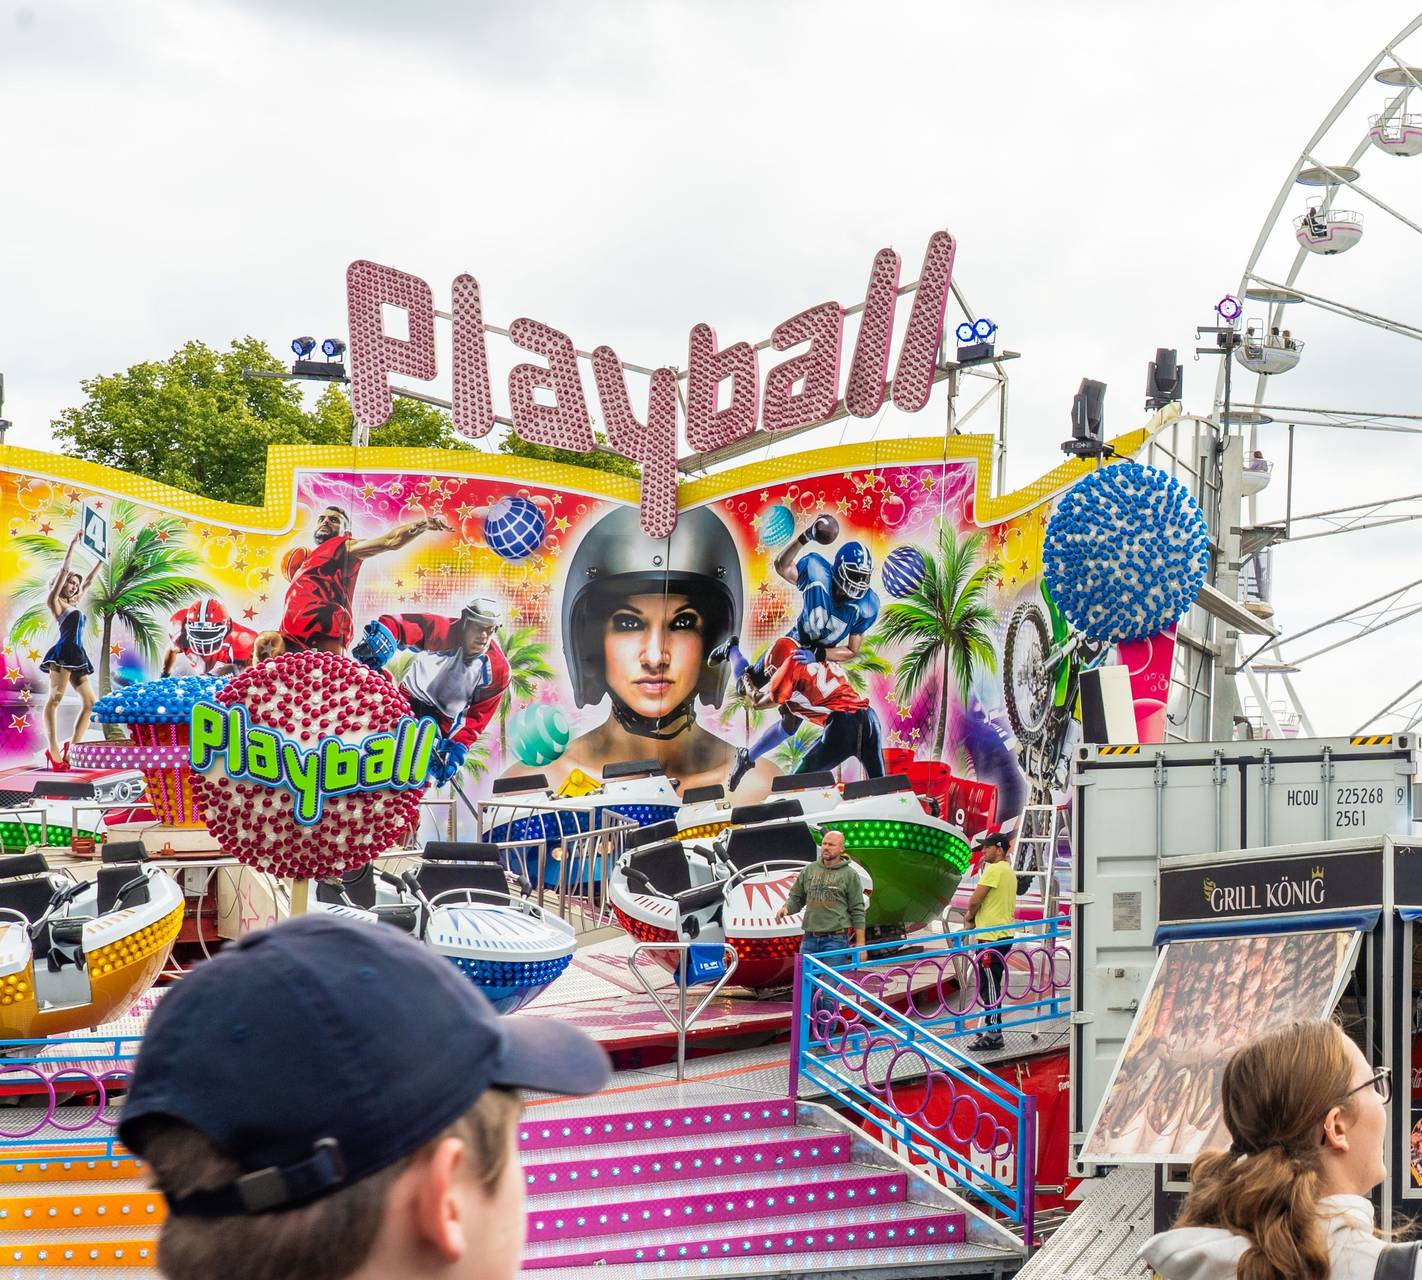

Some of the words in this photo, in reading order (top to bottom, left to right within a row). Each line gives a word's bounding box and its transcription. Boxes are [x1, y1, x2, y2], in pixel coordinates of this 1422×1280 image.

[346, 230, 957, 539] Playball
[191, 701, 437, 823] Playball
[1287, 790, 1319, 806] HCOU
[1336, 787, 1384, 804] 225268
[1396, 788, 1404, 804] 9
[1336, 810, 1366, 827] 25G1
[1210, 885, 1261, 912] GRILL
[1266, 876, 1325, 907] KÖNIG
